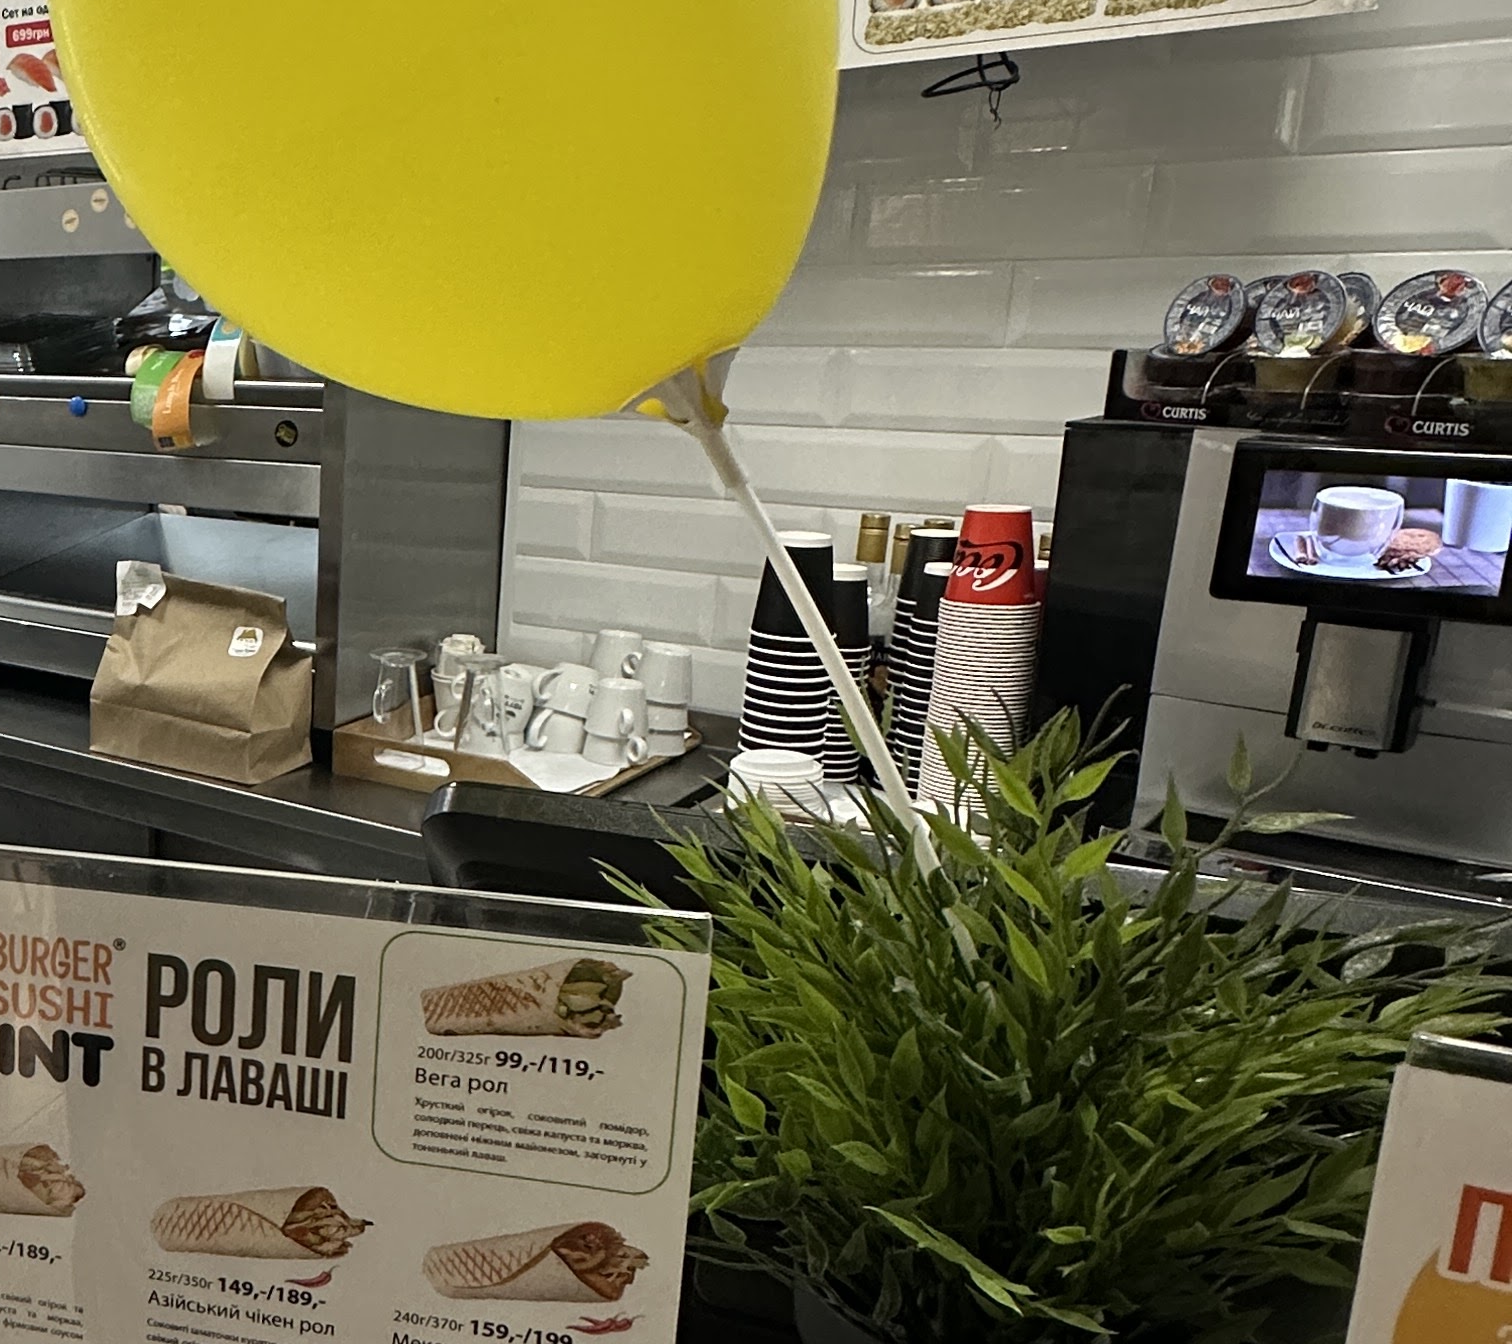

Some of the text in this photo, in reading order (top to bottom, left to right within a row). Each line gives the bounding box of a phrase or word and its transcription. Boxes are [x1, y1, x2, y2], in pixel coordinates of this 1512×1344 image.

[1162, 406, 1207, 420] CURTIS
[1412, 421, 1471, 437] CURTIS
[145, 953, 358, 1063] РОЛИ
[142, 1047, 347, 1119] В ЛАВАШІ
[414, 1067, 509, 1095] Вега рол
[148, 1290, 336, 1337] Азійський чікен рол
